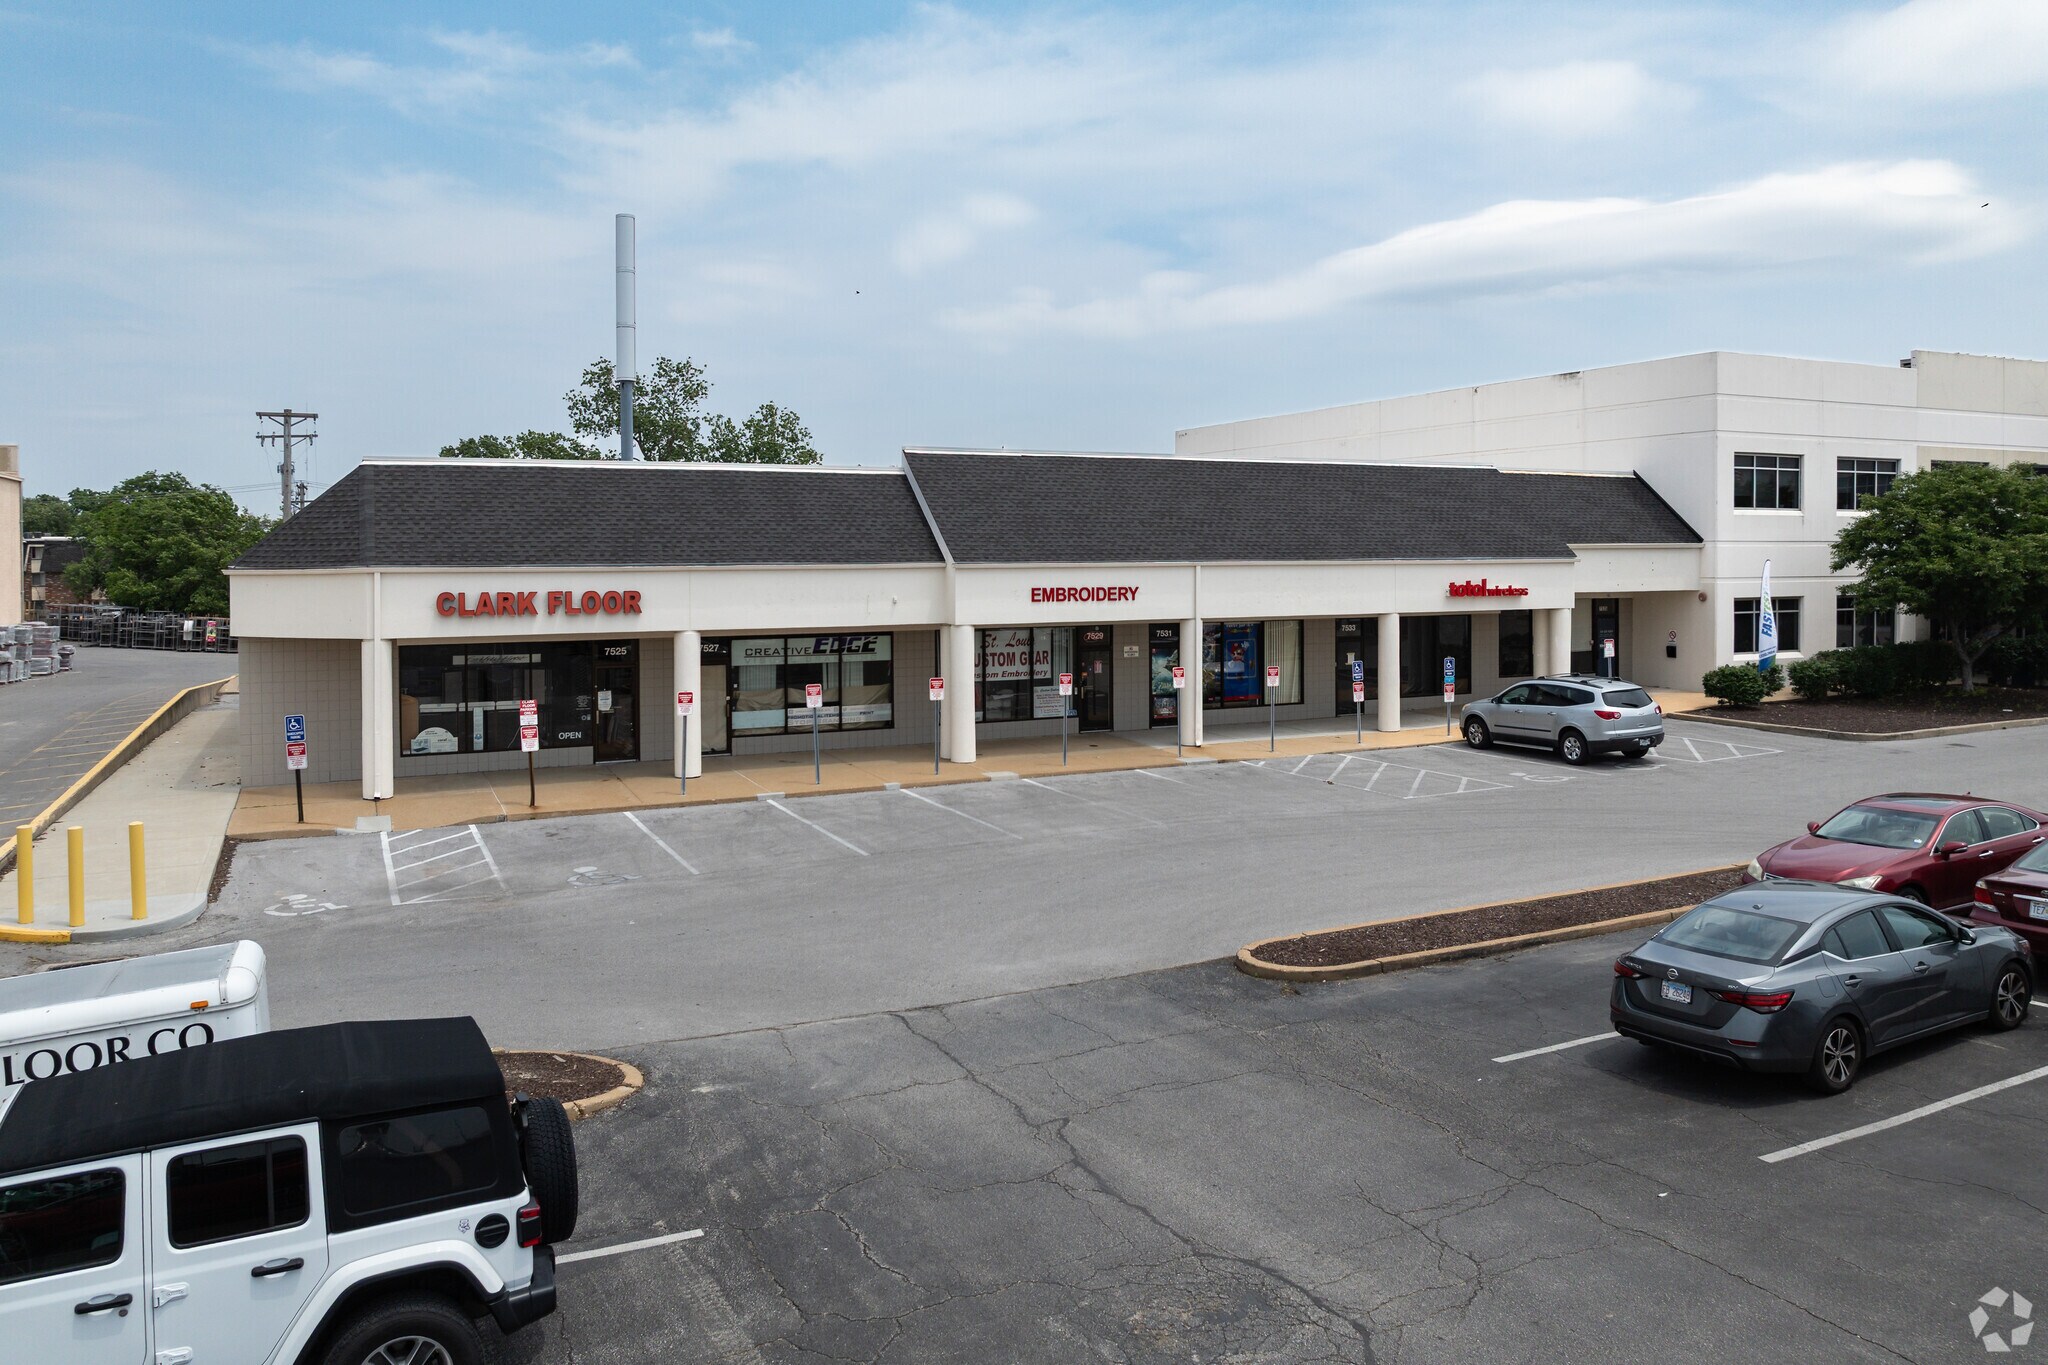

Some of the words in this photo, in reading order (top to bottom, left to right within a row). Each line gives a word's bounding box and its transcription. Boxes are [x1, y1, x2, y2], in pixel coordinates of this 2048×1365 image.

[1449, 578, 1487, 597] total
[1487, 585, 1529, 597] wireless
[1030, 586, 1139, 603] EMBROIDERY
[436, 591, 539, 618] CLARK
[547, 590, 643, 616] FLOOR
[1156, 629, 1172, 638] 7531
[1341, 624, 1357, 632] 7533
[1005, 631, 1032, 648] Loui
[1086, 631, 1104, 640] 7529
[812, 635, 878, 653] EDGE
[604, 647, 628, 656] 7525
[974, 651, 1016, 668] USTOM
[1019, 650, 1050, 666] GAR
[1001, 669, 1049, 679] Embroery
[558, 731, 582, 740] OPEN
[2032, 904, 2046, 915] TE7
